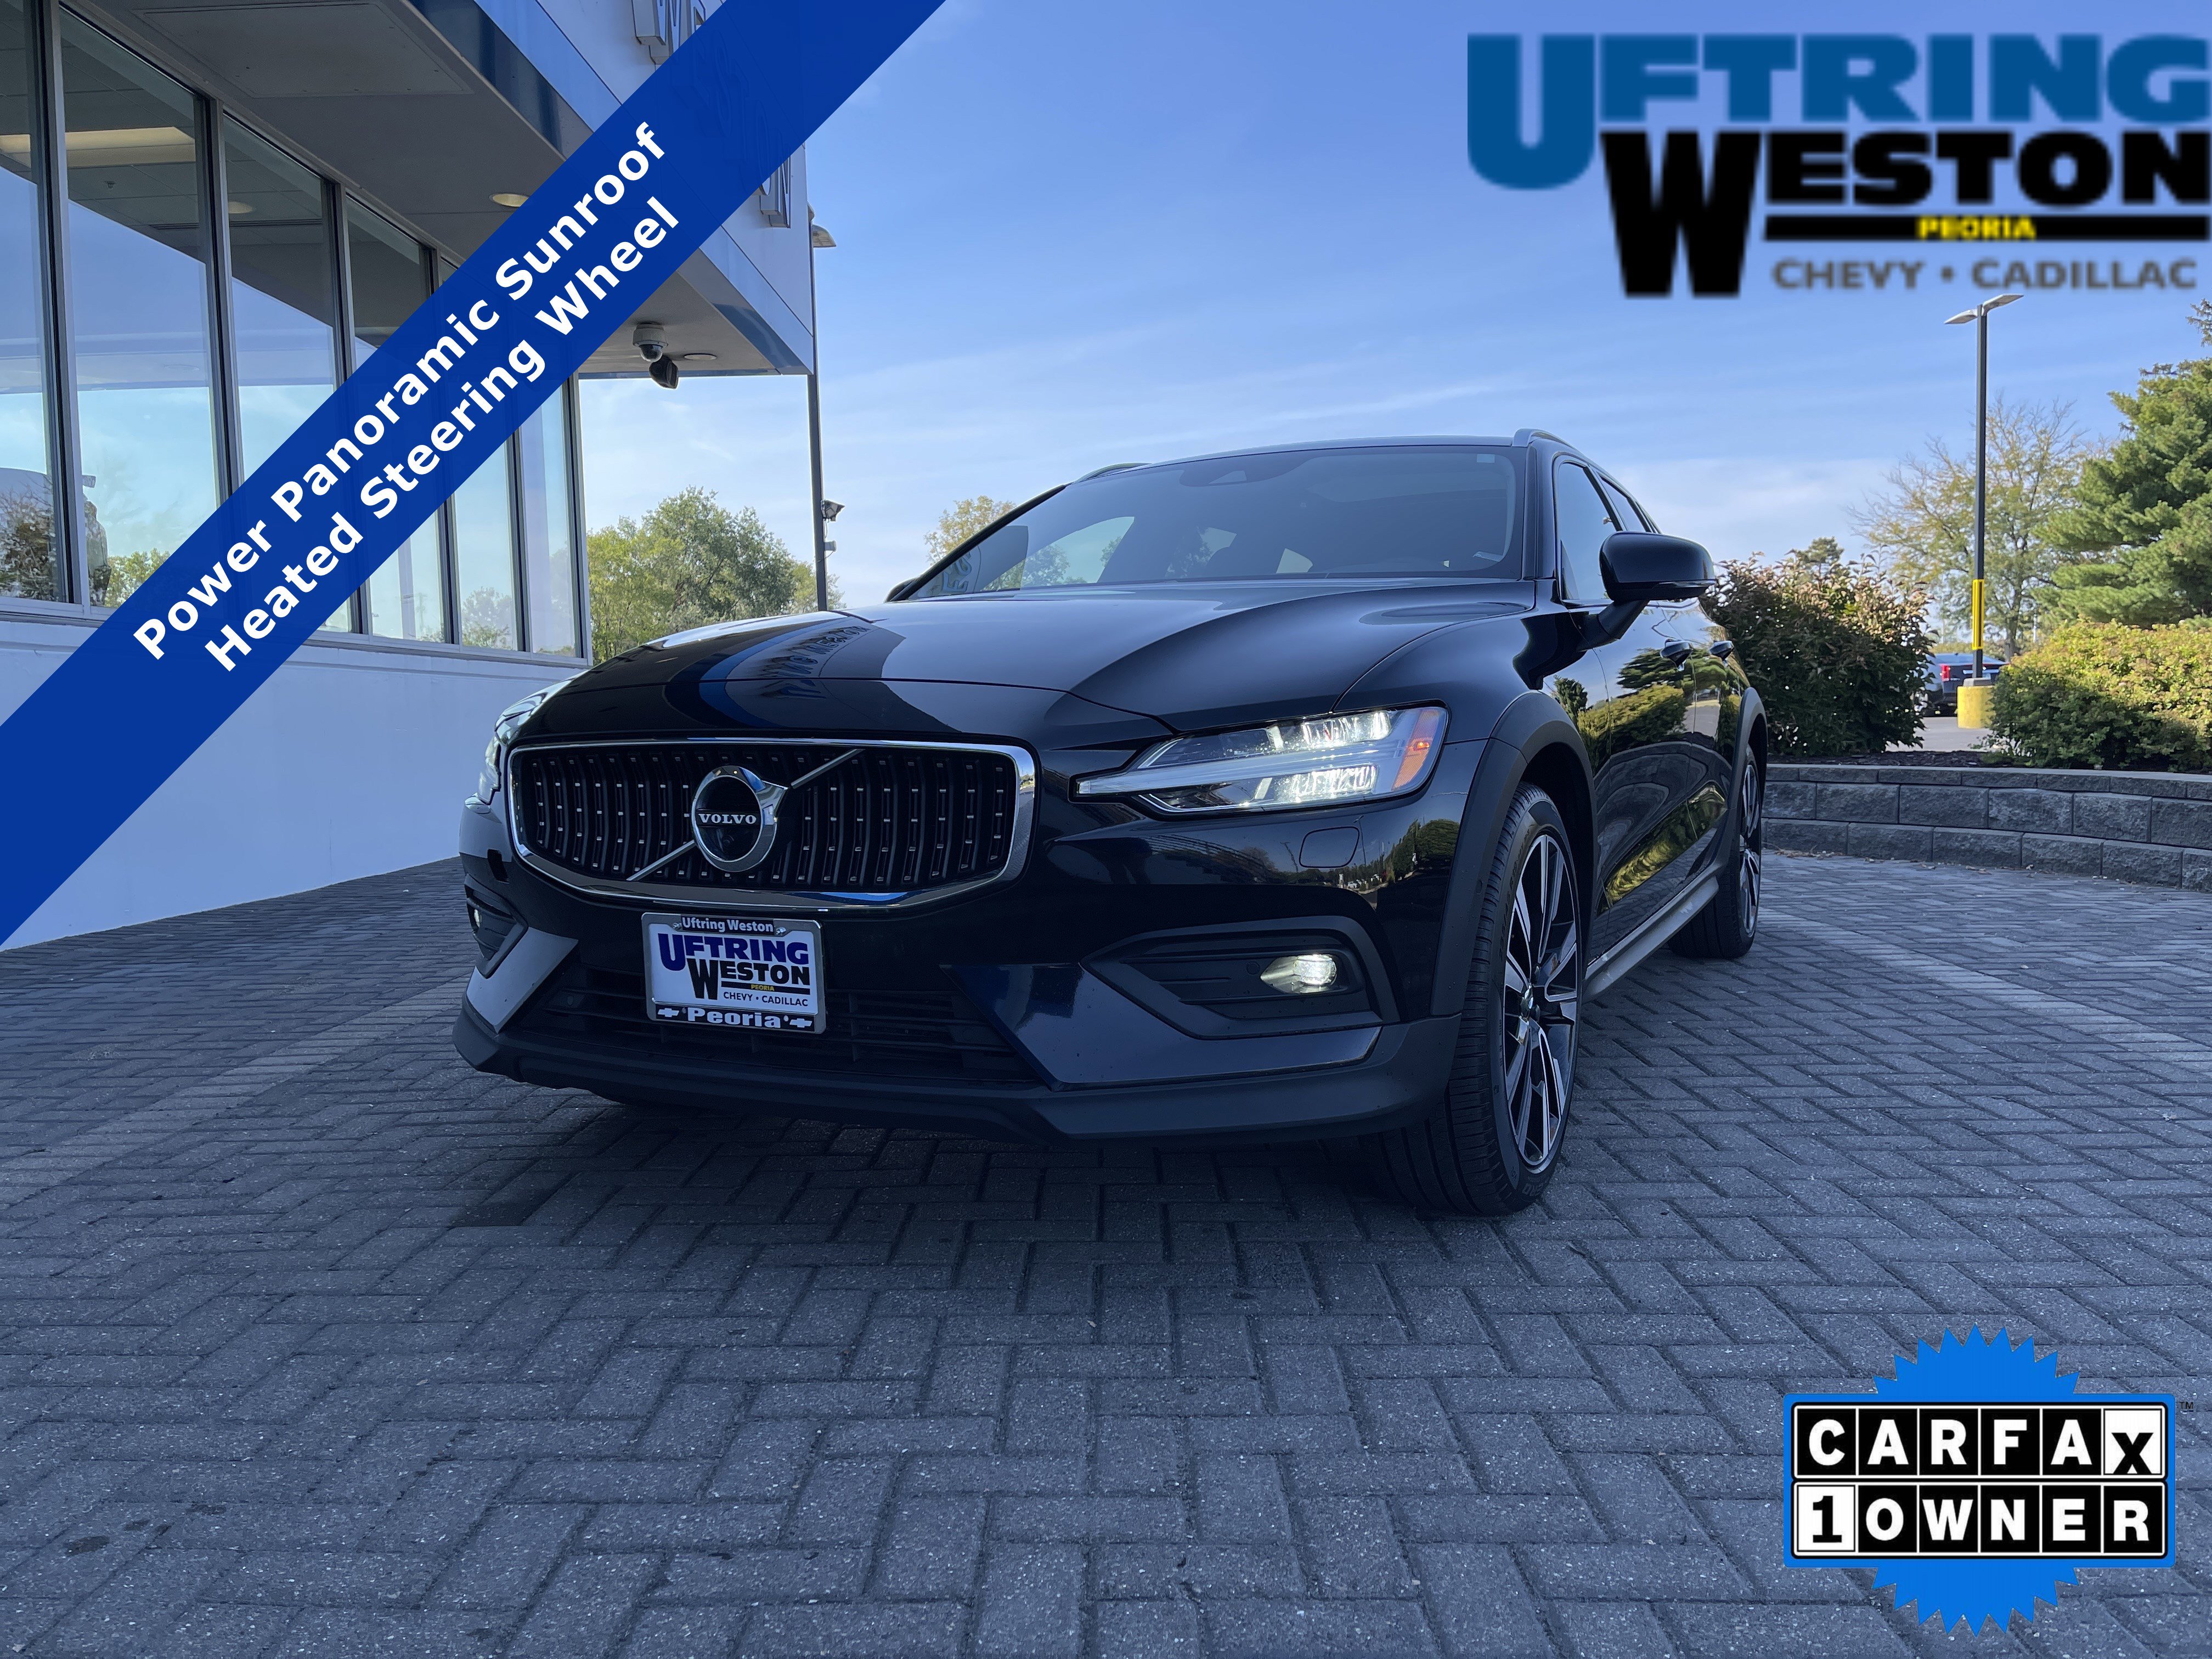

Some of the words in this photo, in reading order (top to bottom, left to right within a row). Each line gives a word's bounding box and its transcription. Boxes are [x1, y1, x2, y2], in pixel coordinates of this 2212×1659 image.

[698, 813, 757, 824] VOLVO
[681, 917, 725, 933] Uftring
[726, 919, 774, 933] Weston
[657, 933, 810, 971] UFTRING
[686, 957, 811, 1001] WESTON
[723, 991, 753, 1002] CHEVY
[761, 995, 809, 1007] CADILLAC
[687, 1007, 781, 1029] Peoria
